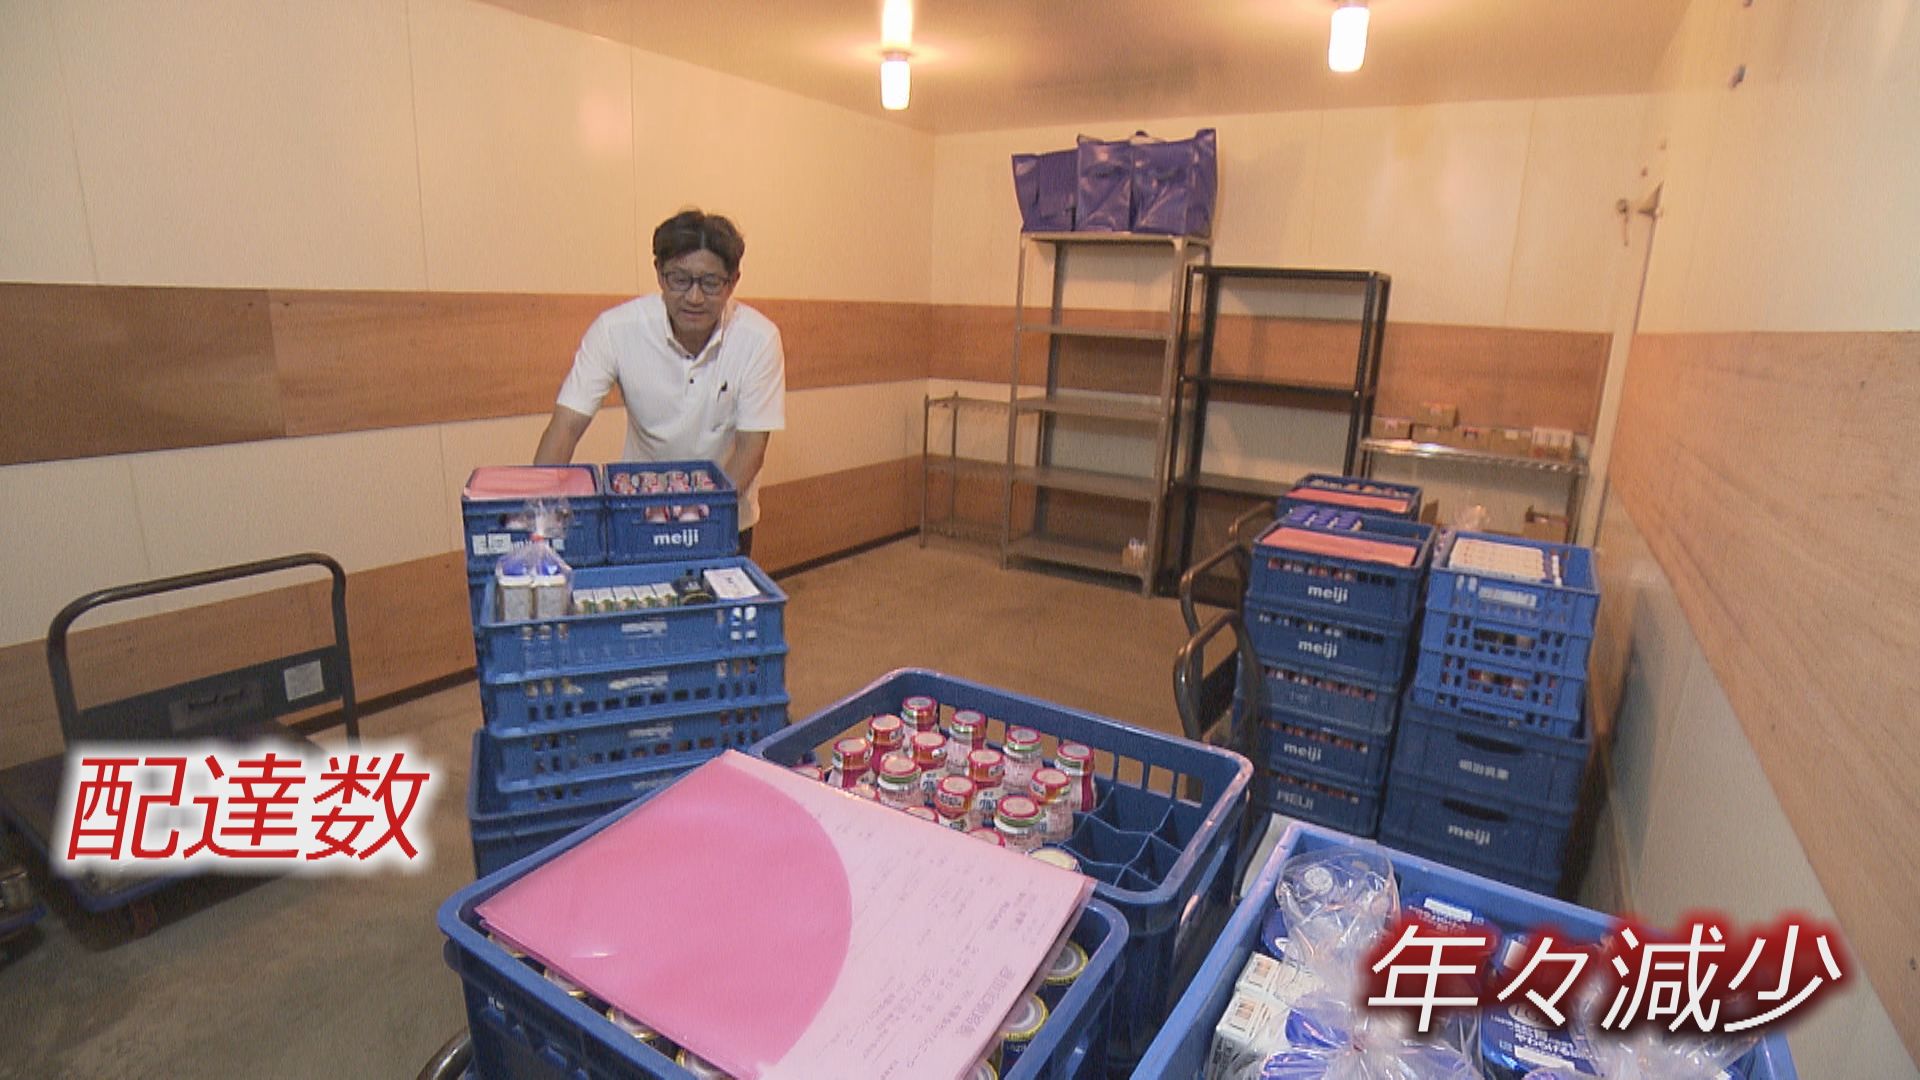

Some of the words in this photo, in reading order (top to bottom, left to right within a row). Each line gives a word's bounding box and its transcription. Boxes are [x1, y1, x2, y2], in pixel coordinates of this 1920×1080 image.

[653, 528, 700, 547] meiji
[1307, 584, 1349, 604] meiji
[1298, 640, 1339, 659] meiji
[1283, 741, 1322, 760] meiji
[1448, 825, 1491, 845] meiji
